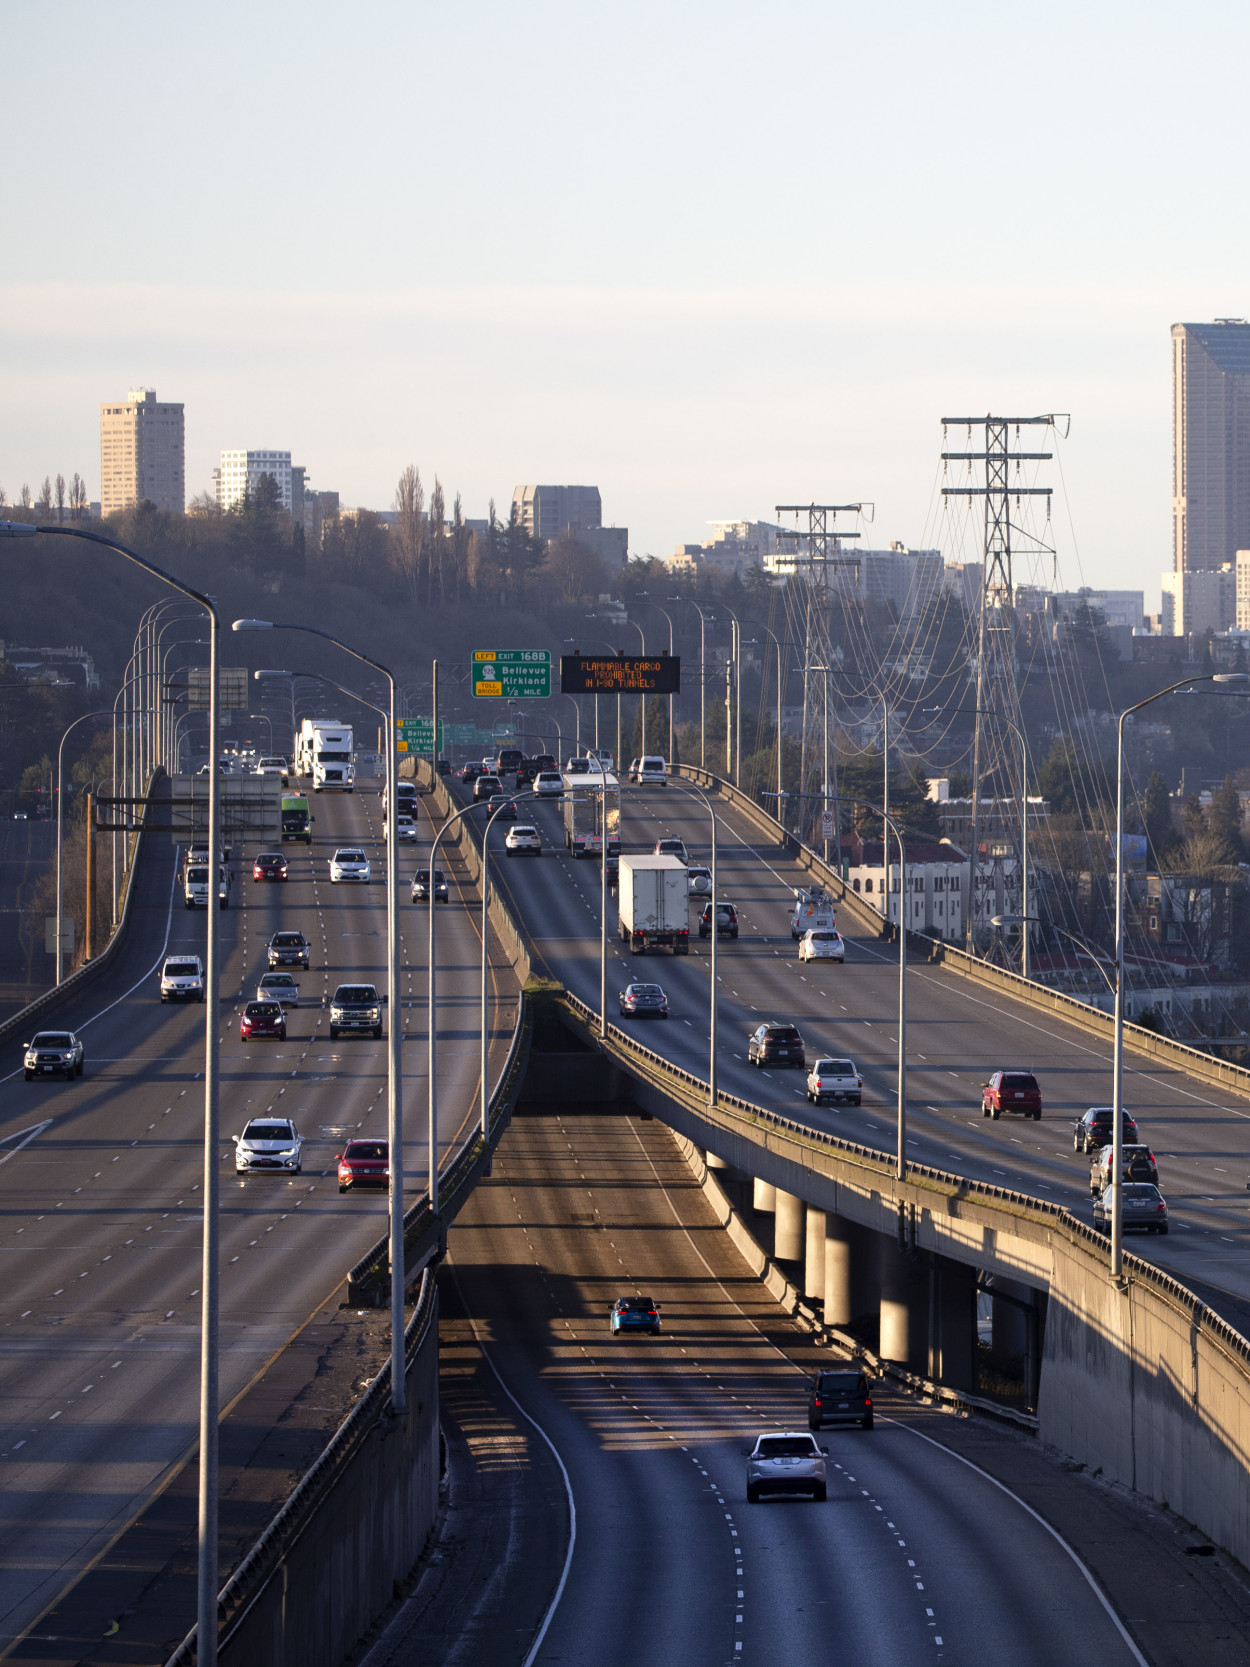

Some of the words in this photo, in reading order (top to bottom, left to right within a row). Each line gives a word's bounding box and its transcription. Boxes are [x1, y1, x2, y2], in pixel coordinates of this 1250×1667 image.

[476, 652, 495, 660] LEFT
[520, 652, 546, 661] 168B
[502, 666, 546, 675] Bellevue
[581, 662, 630, 671] FLAMMABLE
[634, 662, 661, 671] CARGO
[594, 670, 642, 679] PROHIBITED
[502, 676, 546, 685] Kirkland
[585, 679, 593, 688] IN
[596, 679, 614, 688] I-90
[617, 679, 656, 688] TUNNELS
[507, 686, 519, 696] 1/2
